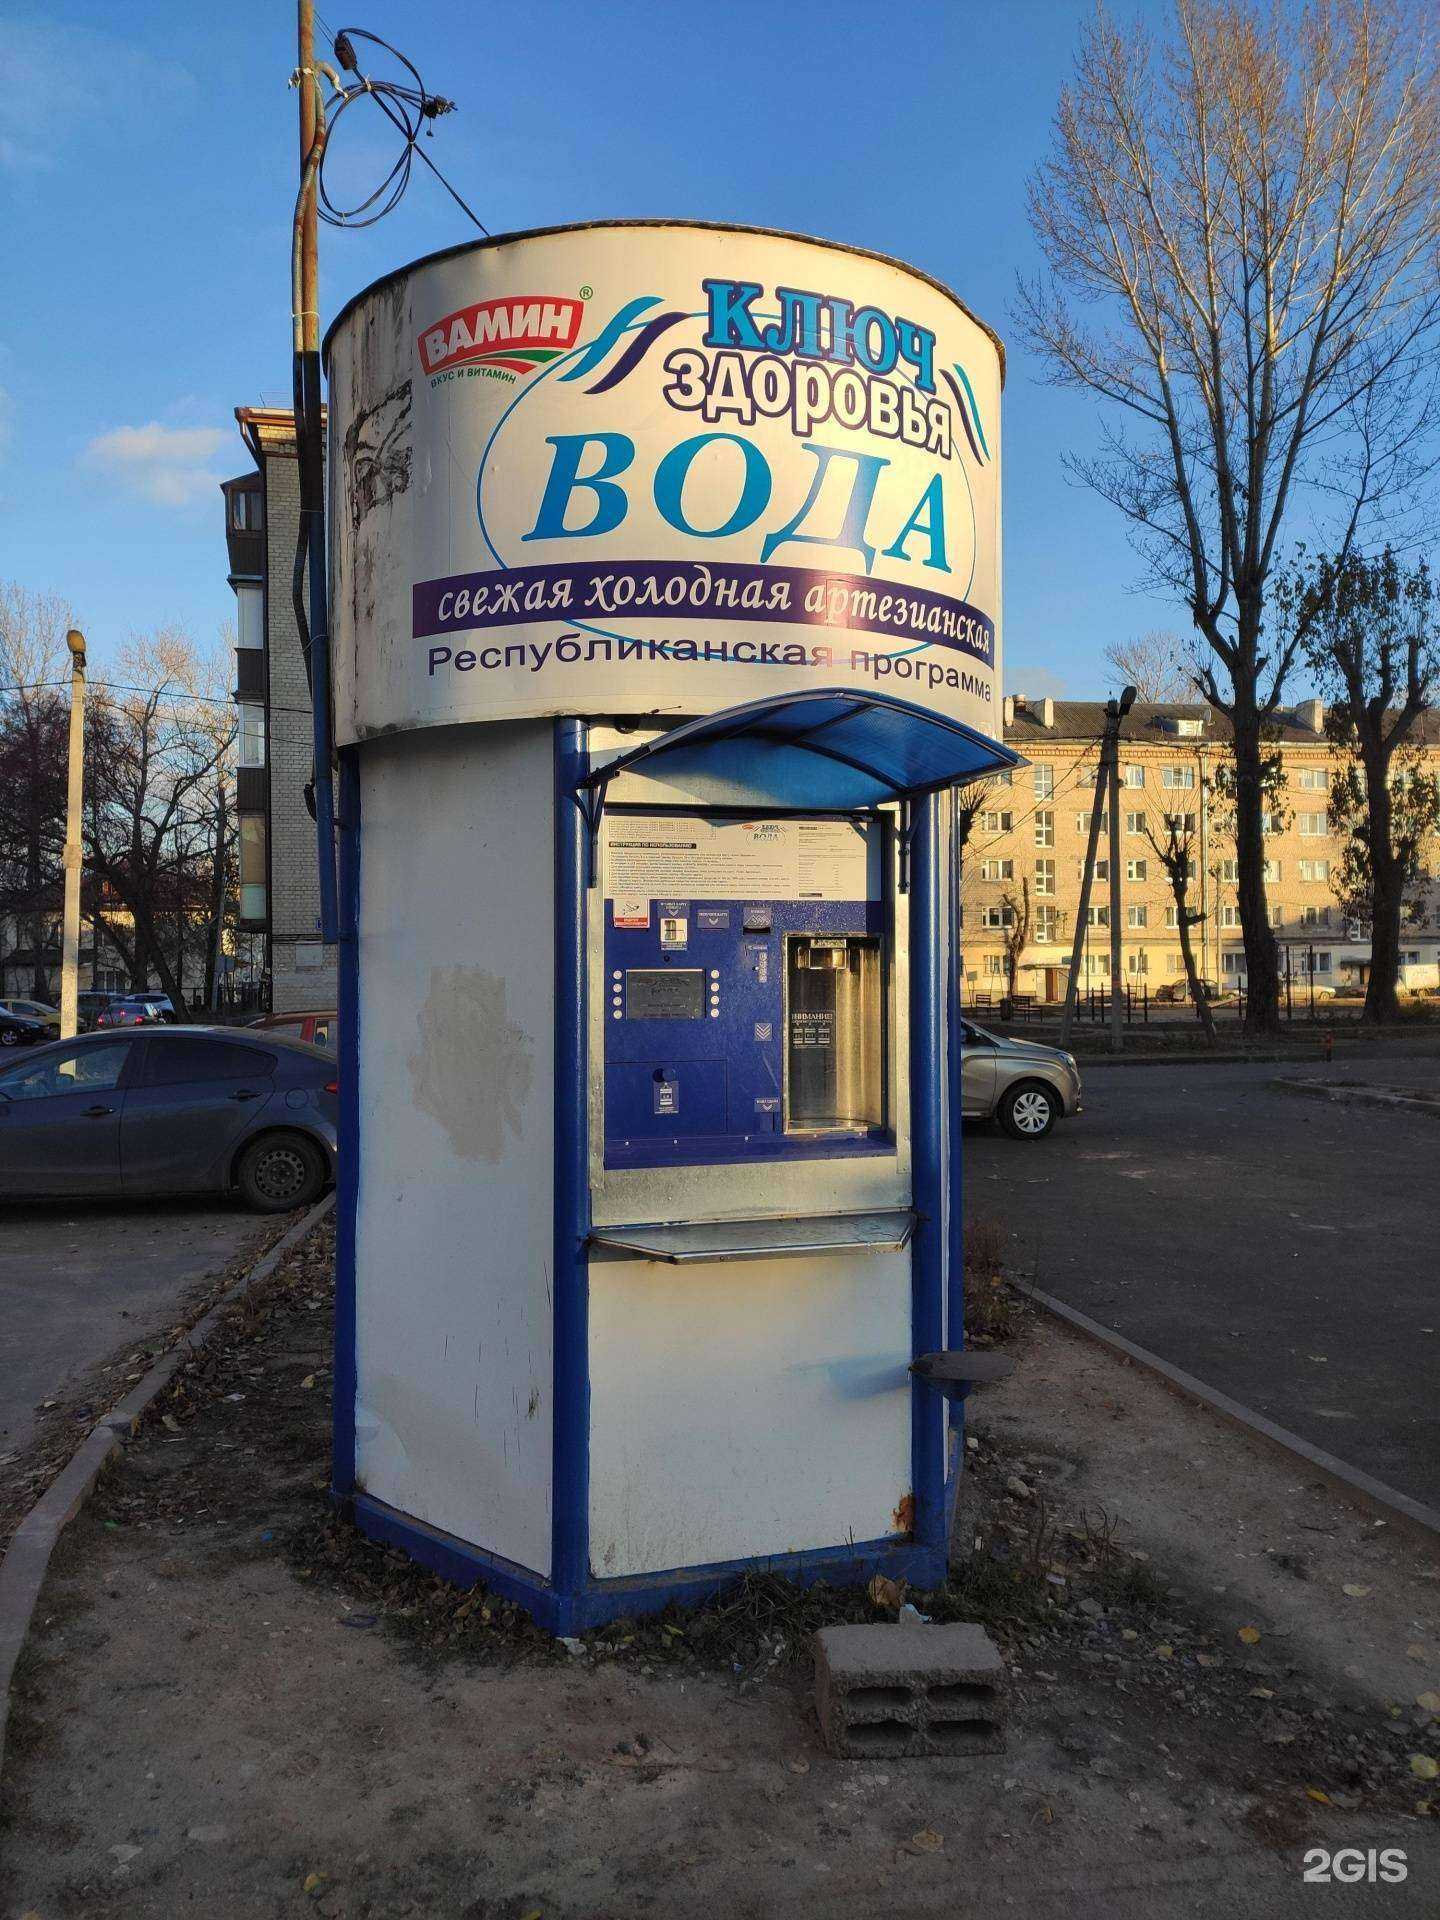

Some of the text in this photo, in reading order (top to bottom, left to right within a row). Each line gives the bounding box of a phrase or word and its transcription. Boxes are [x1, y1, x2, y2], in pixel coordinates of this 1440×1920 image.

[424, 304, 573, 368] ВАМИН
[430, 367, 517, 389] ВКУС И ВИТАМИН
[702, 278, 936, 395] КЛЮЧ
[663, 348, 951, 461] ЗДОРОВЬЯ
[521, 432, 952, 575] ВОДА
[438, 564, 990, 655] свежая холодная артезианская
[428, 633, 992, 703] Республиканская программа
